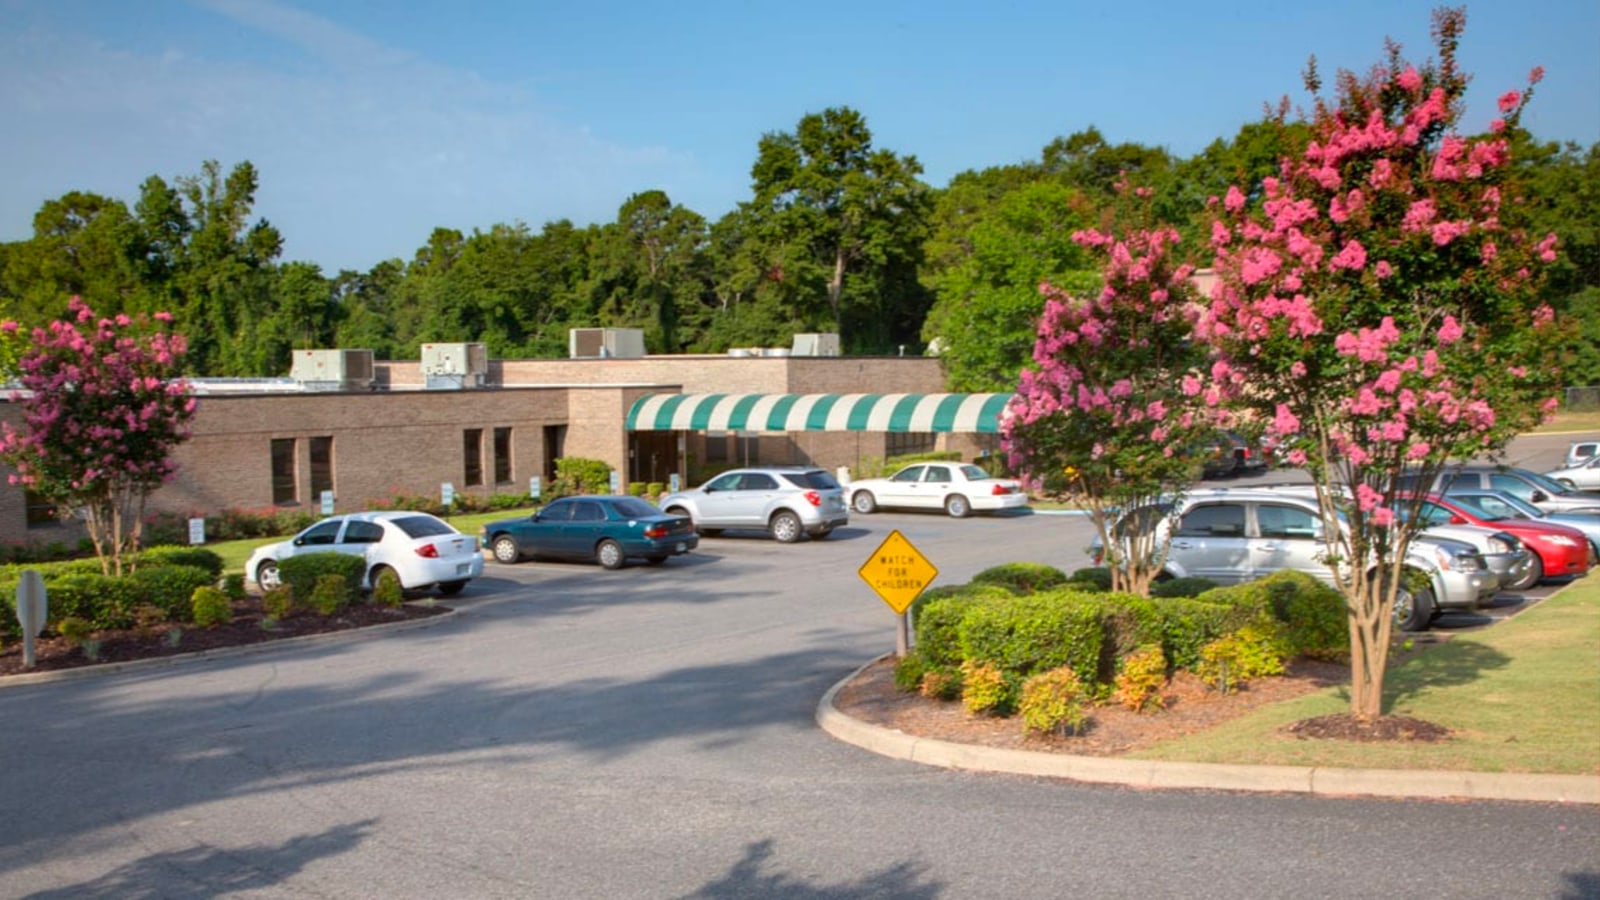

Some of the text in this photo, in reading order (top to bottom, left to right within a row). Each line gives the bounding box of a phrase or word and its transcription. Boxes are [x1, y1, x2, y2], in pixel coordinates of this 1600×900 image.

[880, 555, 914, 565] WATCH
[888, 567, 907, 577] FOR
[876, 579, 922, 589] CHILDREN
